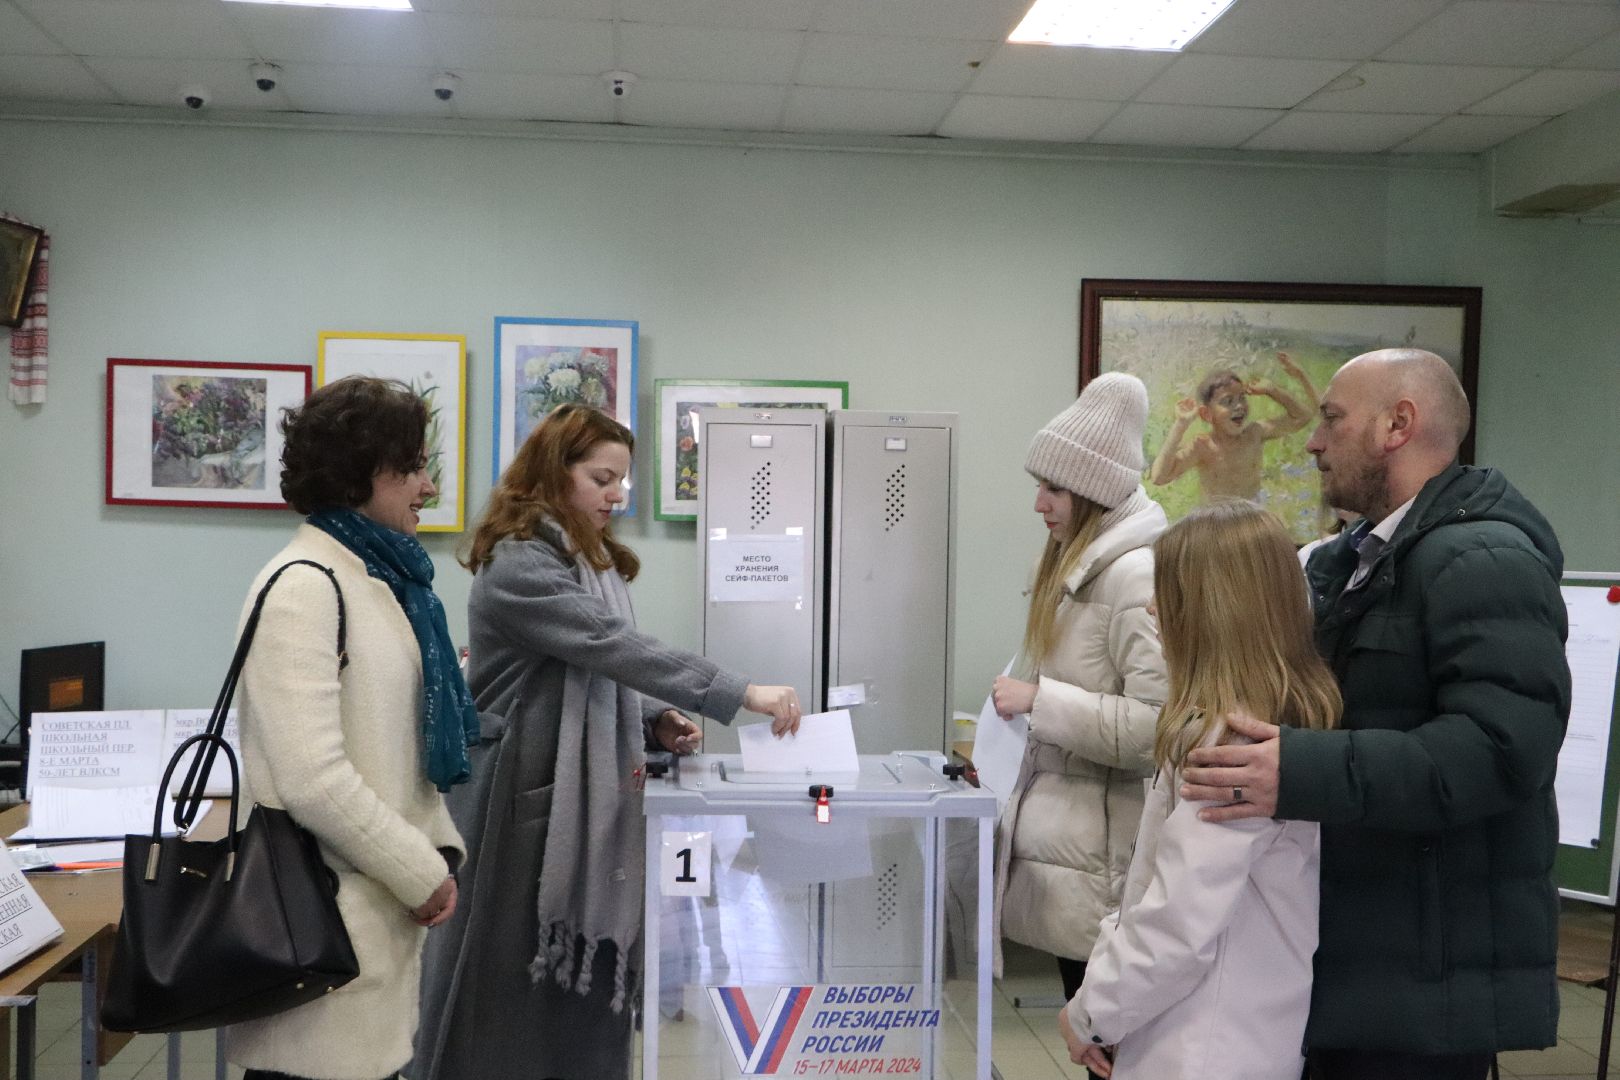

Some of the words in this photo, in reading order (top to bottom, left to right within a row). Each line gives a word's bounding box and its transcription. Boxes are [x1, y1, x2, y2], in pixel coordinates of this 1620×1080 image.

[725, 574, 789, 582] СЕЙФ-ПАКЕТОВ
[41, 721, 111, 731] СОВЕТСКАЯ
[41, 733, 108, 743] ШКОЛЬНАЯ
[40, 743, 109, 755] ШКОЛЬНЫЙ
[59, 756, 100, 765] МАРТА
[79, 767, 121, 776] ВЛКСМ
[675, 848, 696, 882] 1
[0, 873, 23, 895] КАЯ
[824, 986, 914, 1004] ВЫБОРЫ
[812, 1010, 940, 1030] ПРЕЗИДЕНТА
[801, 1035, 885, 1053] РОССИИ
[835, 1058, 885, 1074] МАРТА
[887, 1057, 921, 1073] 2024
